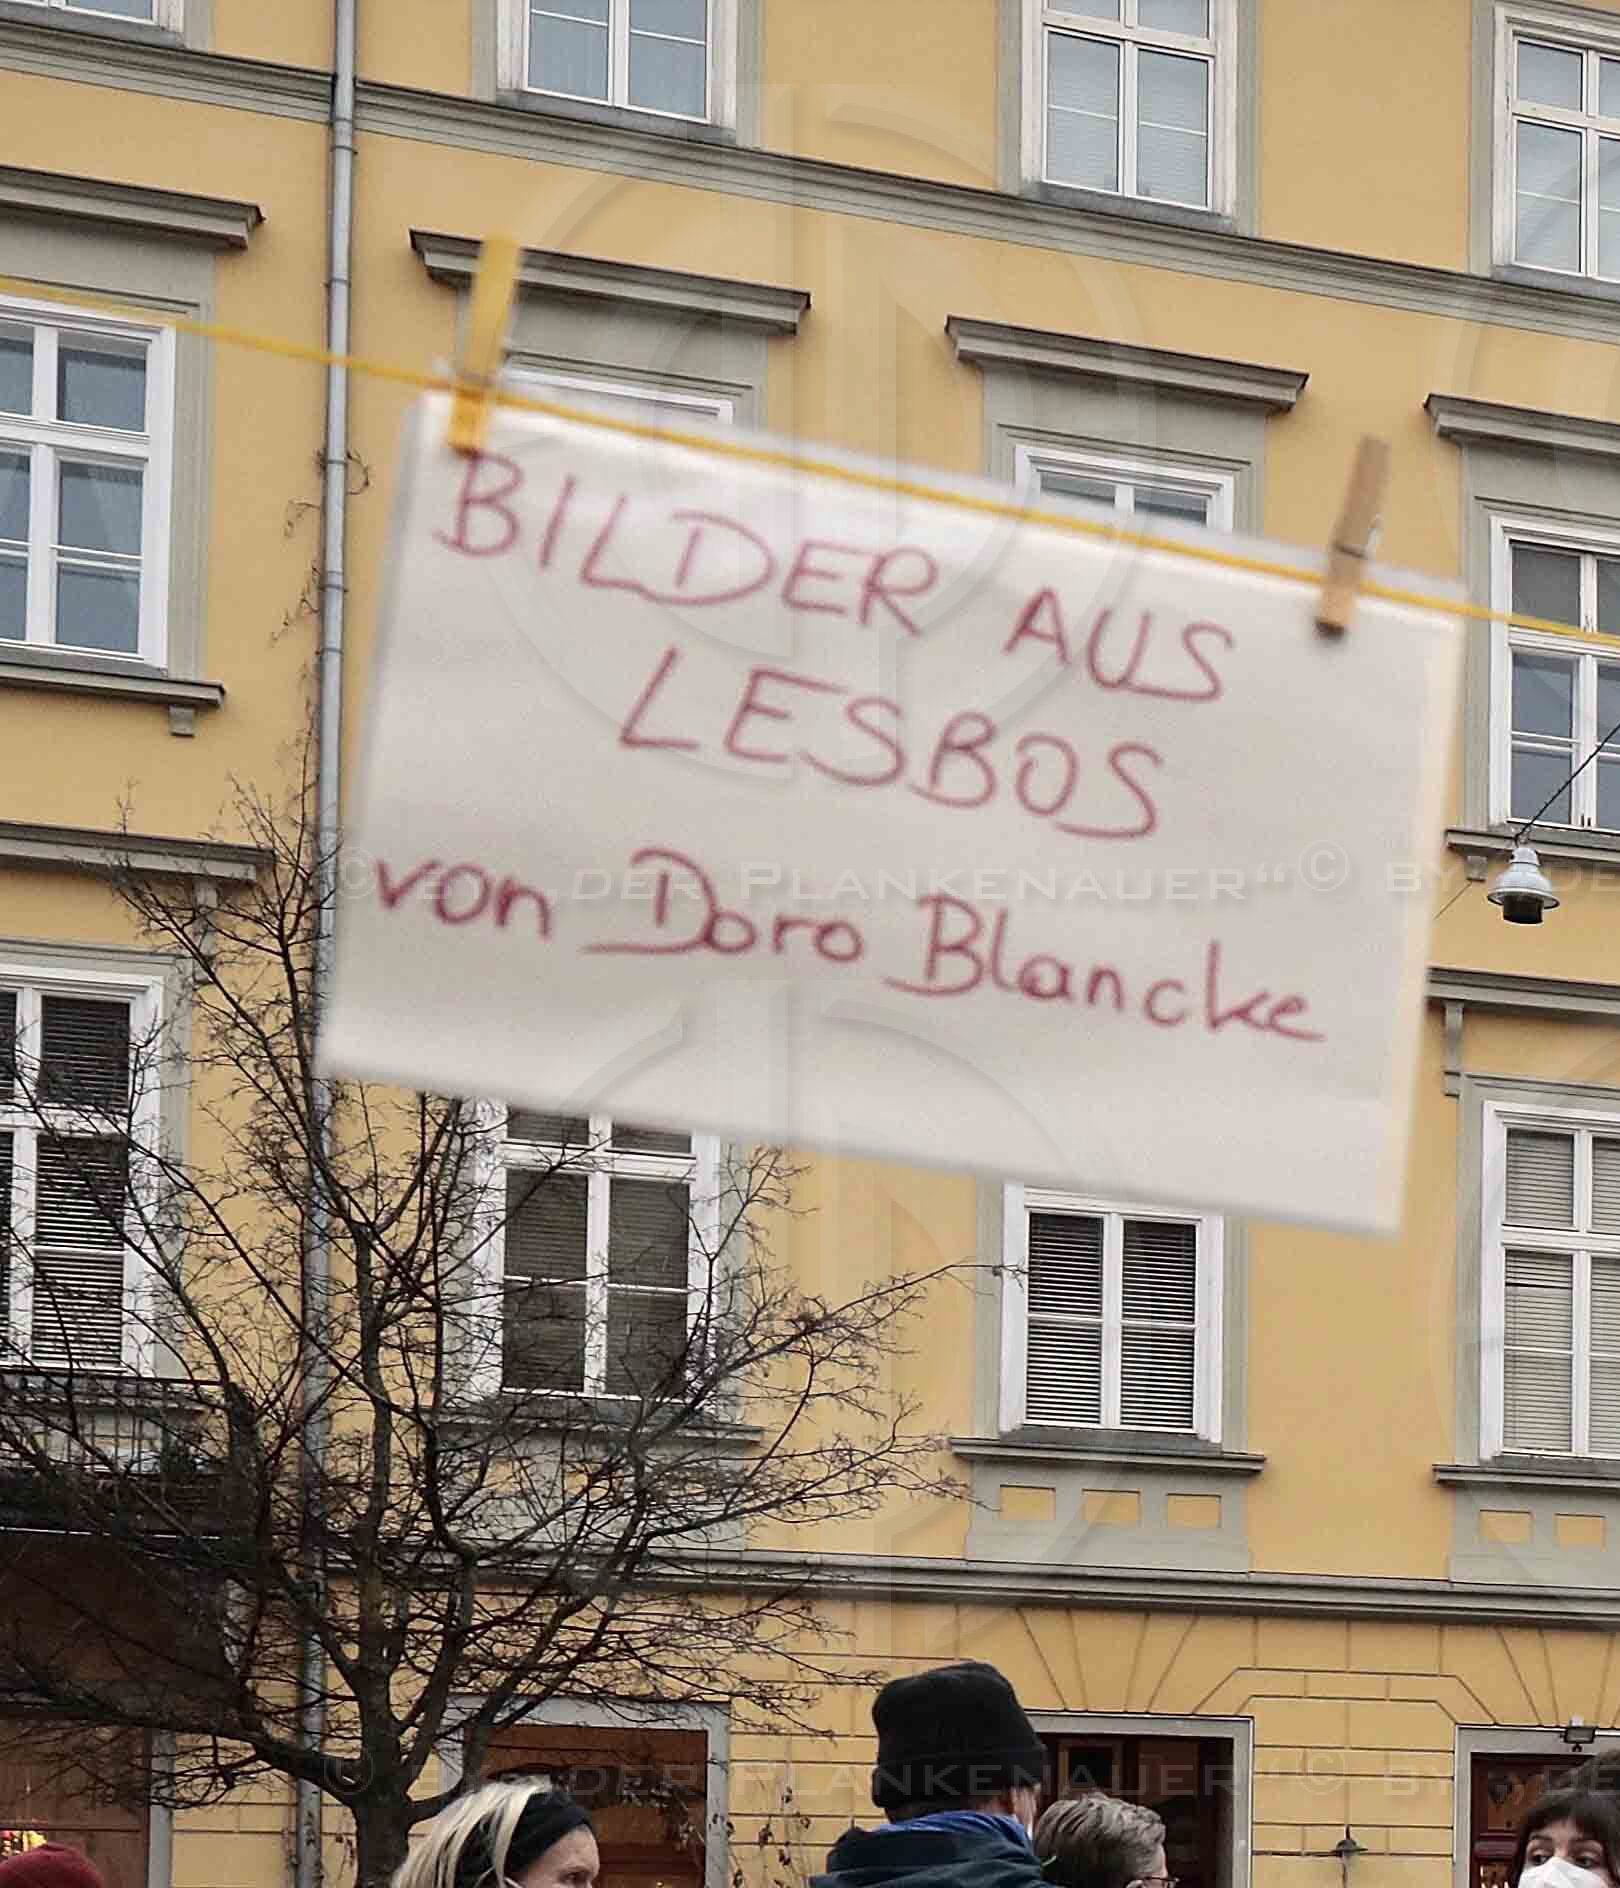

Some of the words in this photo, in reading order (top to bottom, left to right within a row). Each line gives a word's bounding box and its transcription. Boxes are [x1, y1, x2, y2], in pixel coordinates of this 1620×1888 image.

[431, 450, 939, 638] BILDER
[1003, 584, 1234, 702] AUS
[617, 645, 1165, 841] LESBOS
[374, 856, 553, 941] von
[582, 846, 865, 965] Doro
[882, 892, 1328, 1044] Blancke
